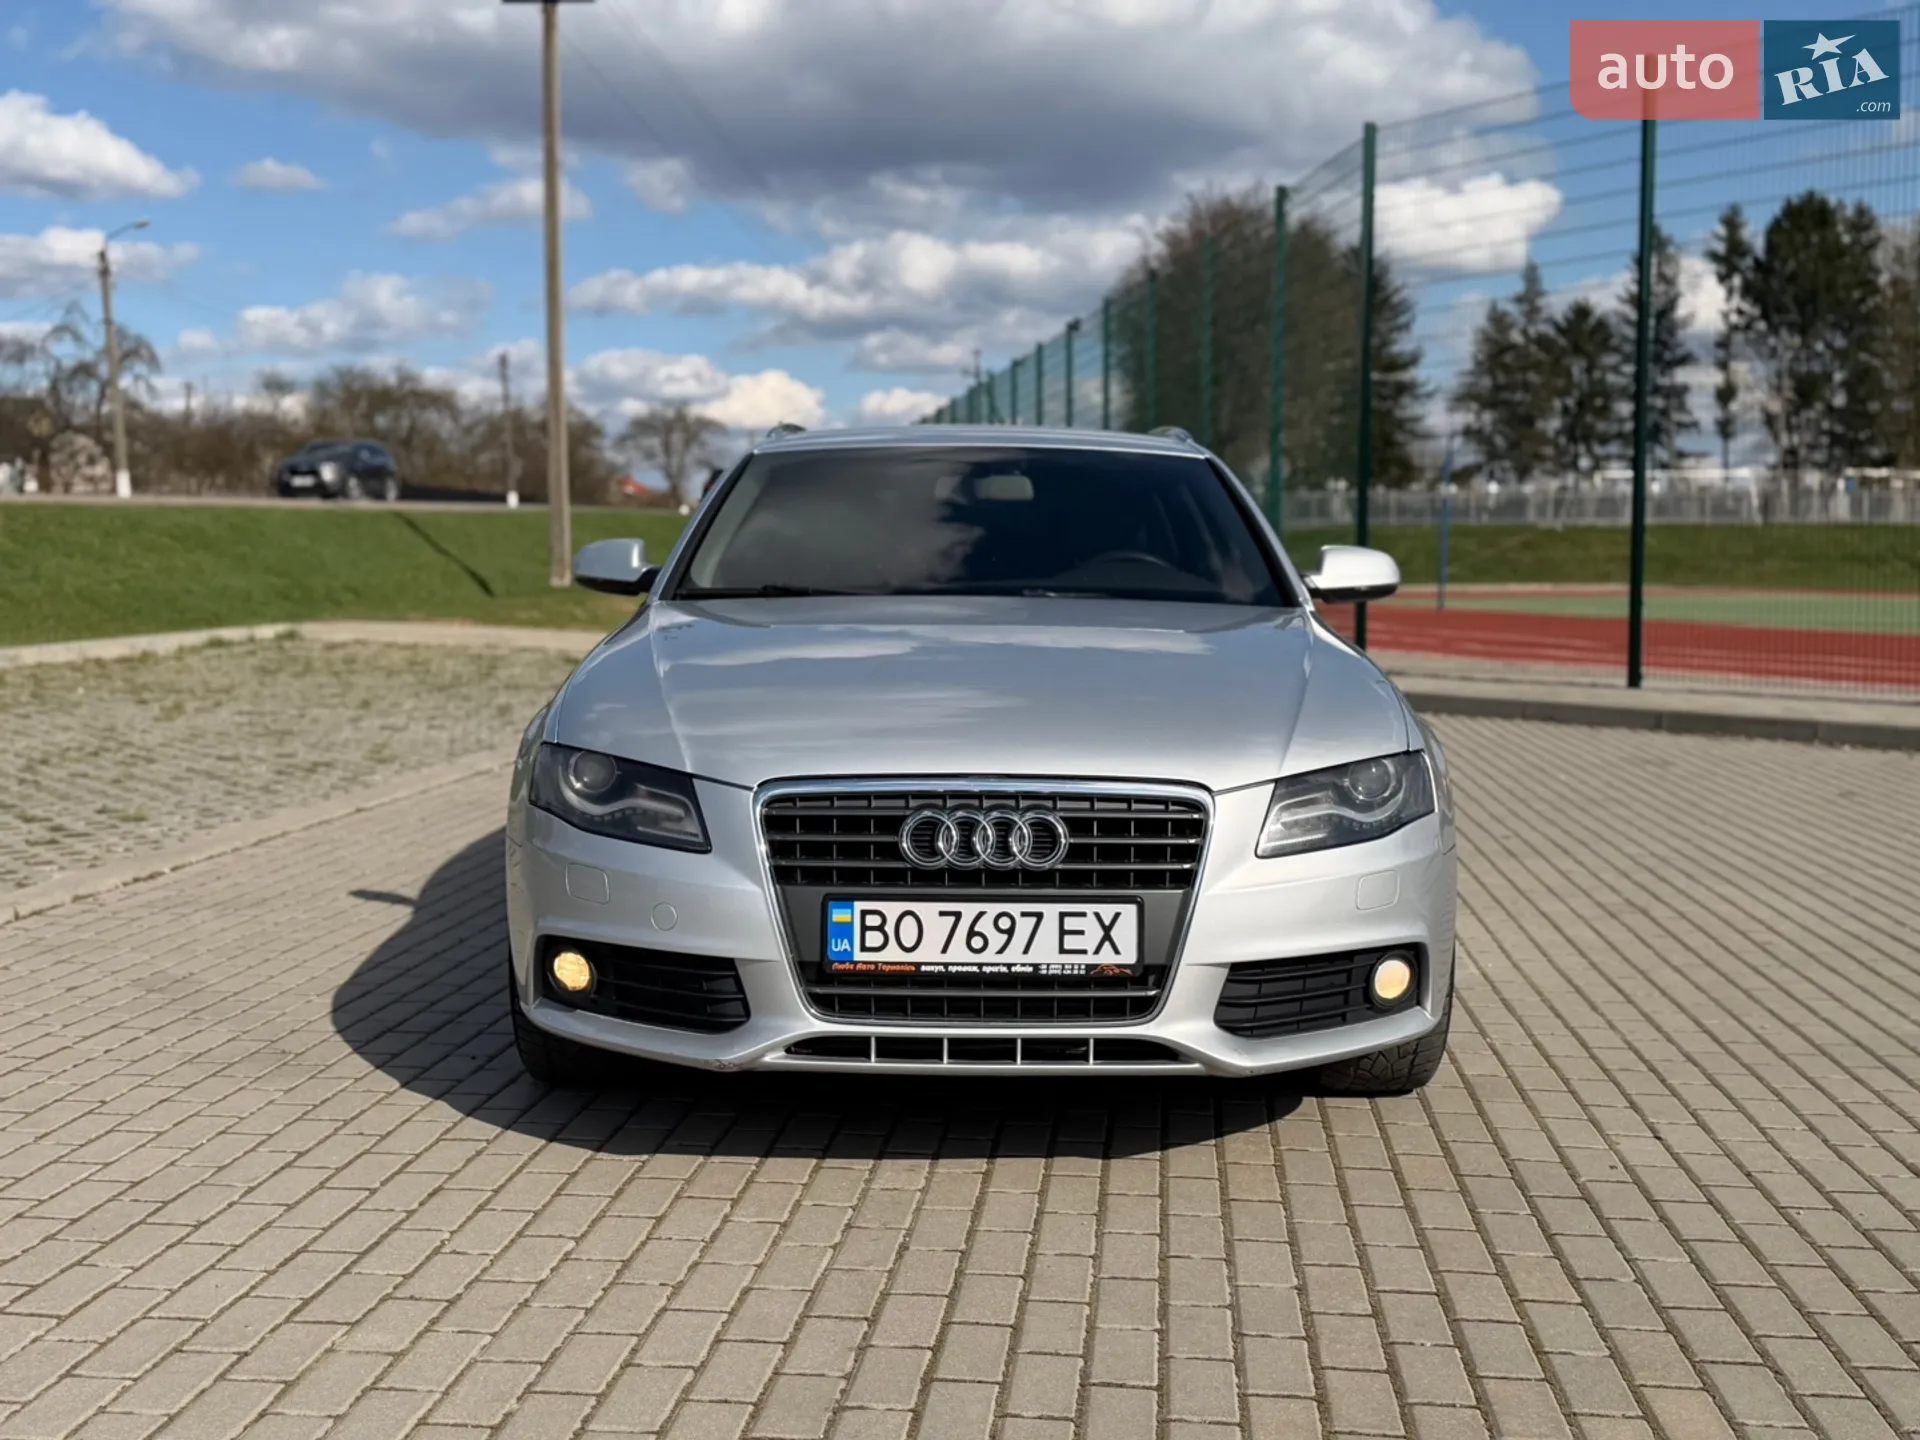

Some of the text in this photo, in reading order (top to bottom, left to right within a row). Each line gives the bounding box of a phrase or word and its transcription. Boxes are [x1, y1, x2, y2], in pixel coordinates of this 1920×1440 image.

[831, 938, 851, 952] UA
[859, 909, 1122, 955] BO 7697 EX
